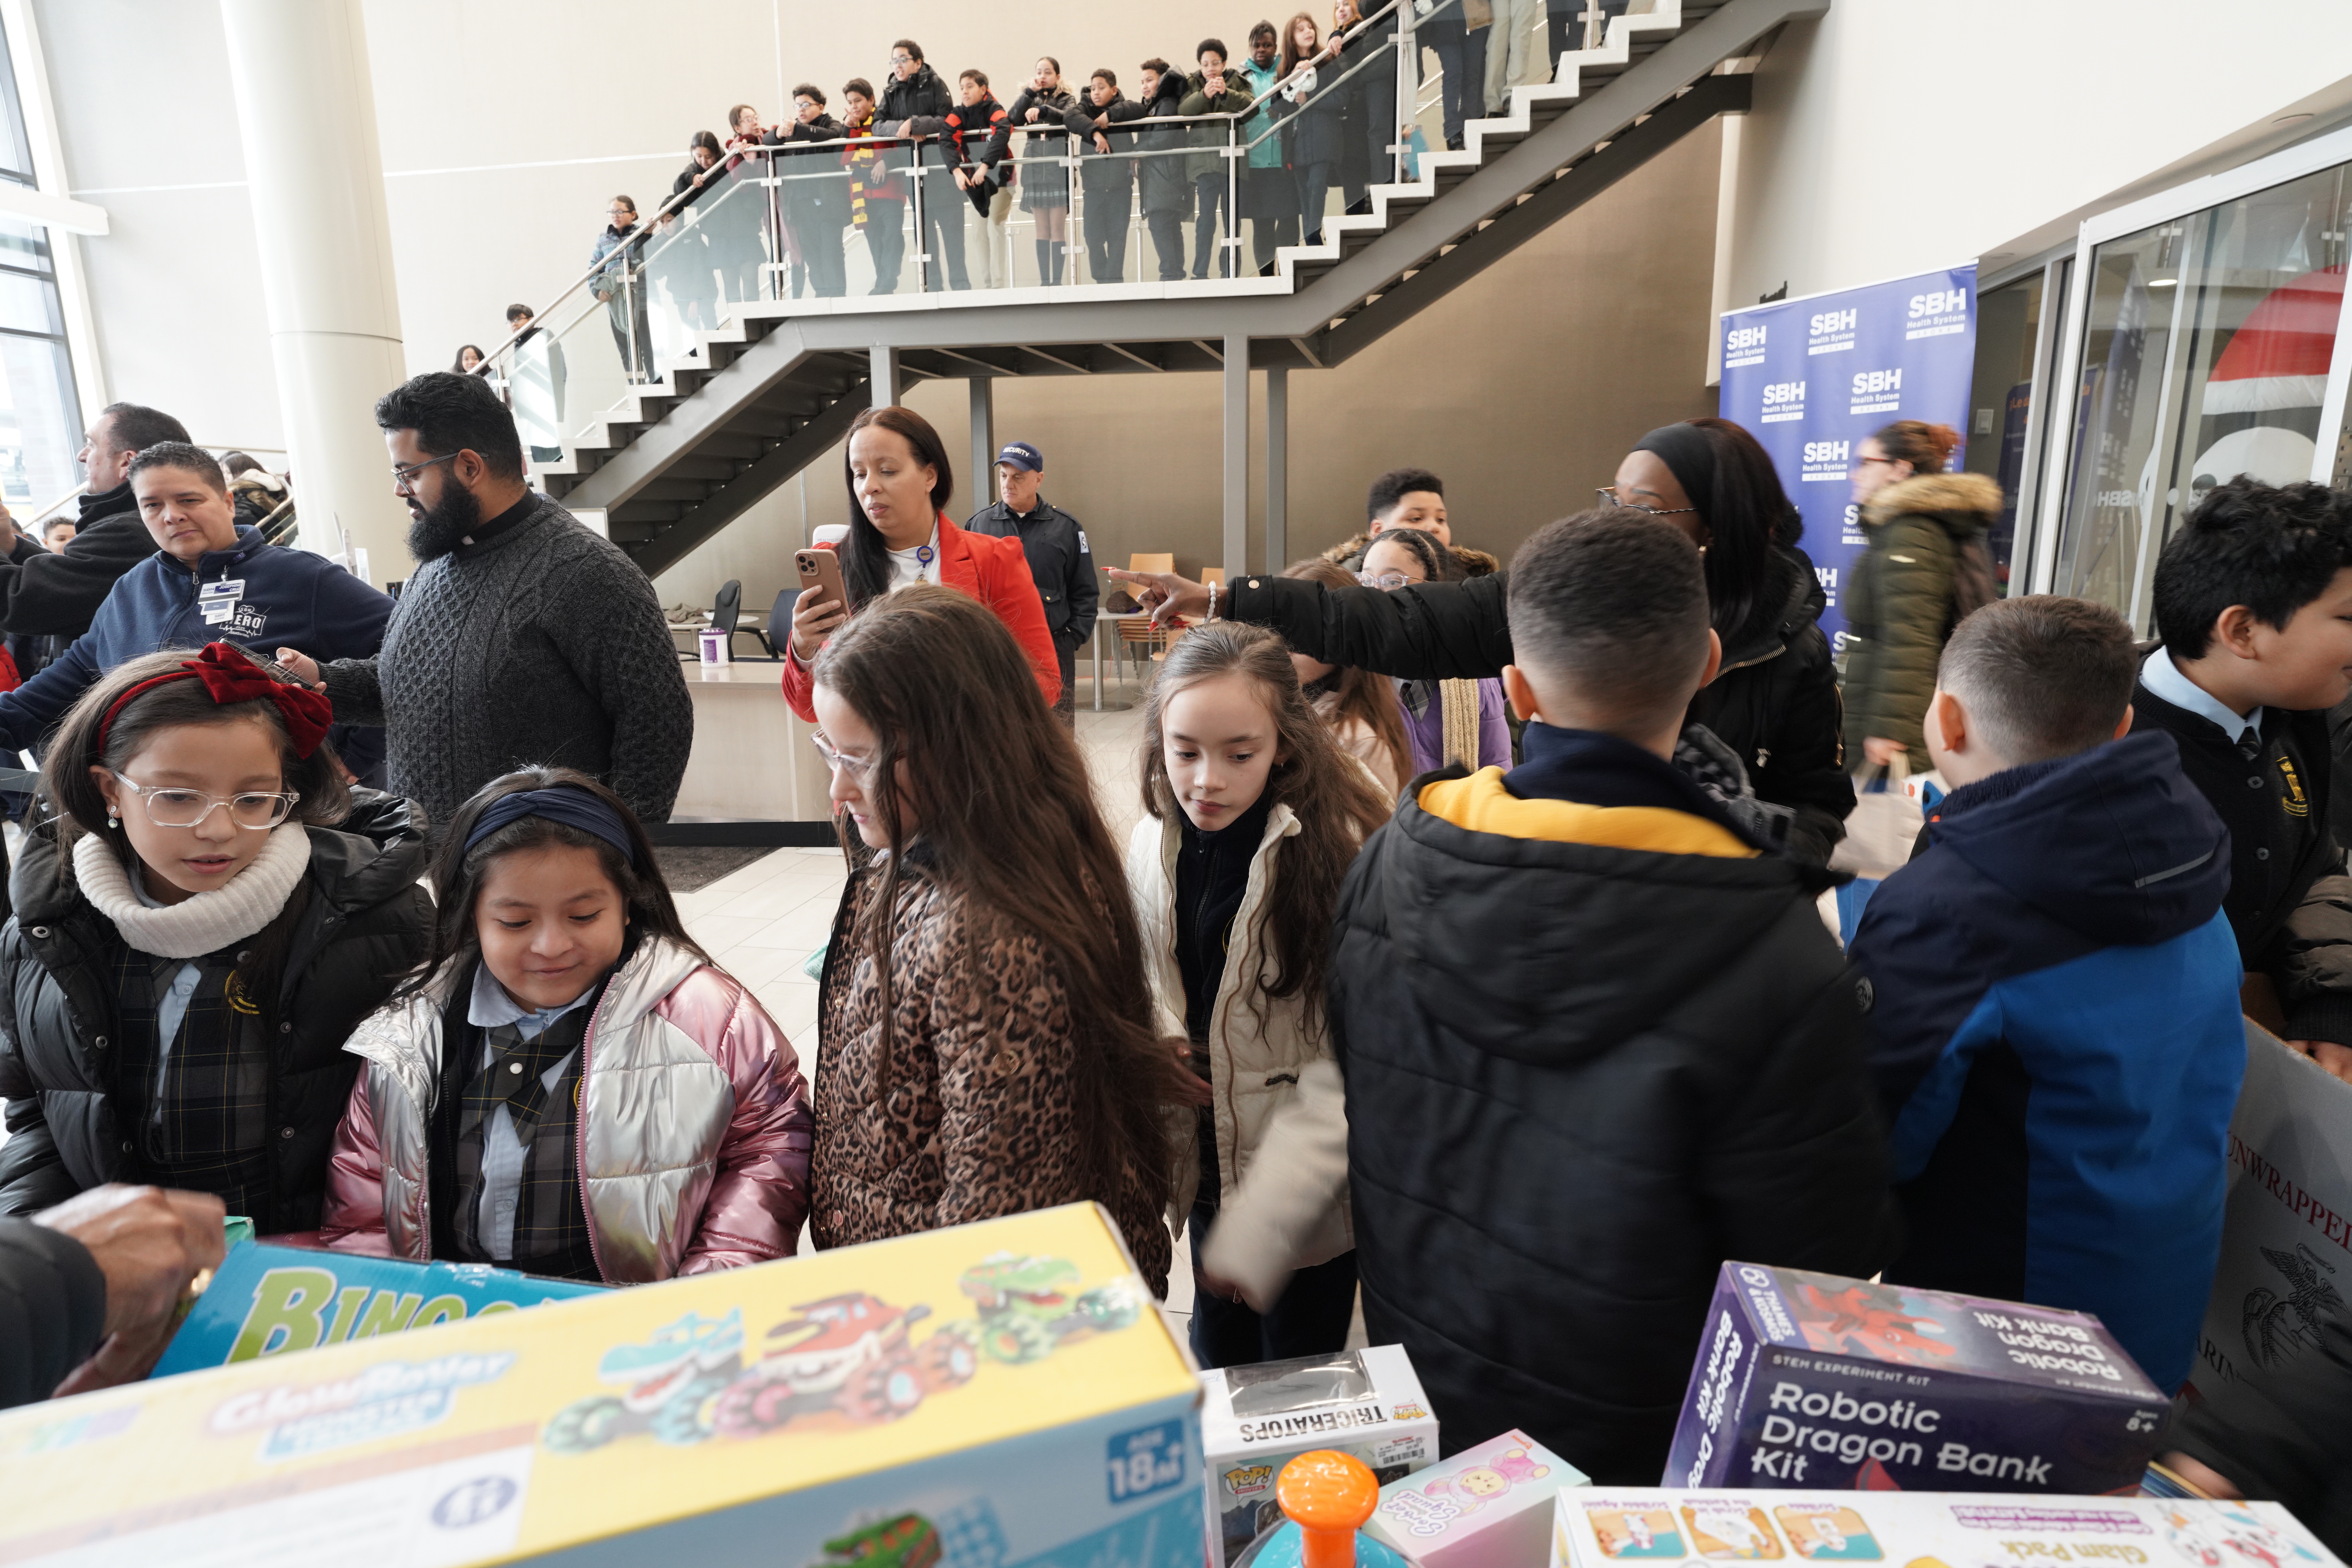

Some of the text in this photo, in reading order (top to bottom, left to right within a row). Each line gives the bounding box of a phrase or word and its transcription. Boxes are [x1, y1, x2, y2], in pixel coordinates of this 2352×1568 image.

[1908, 288, 1966, 318] SBH
[1810, 308, 1857, 335] SBH
[1907, 314, 1965, 329] Health System
[1727, 325, 1766, 350] SBH
[1809, 332, 1854, 345] Health System
[1726, 348, 1765, 359] Health System
[1763, 381, 1805, 405] SBH
[1852, 368, 1902, 394] SBH
[1762, 404, 1804, 413] Health System
[1851, 393, 1899, 404] Health System
[1003, 447, 1030, 457] SECURITY
[1804, 441, 1849, 463] SBH
[1823, 463, 1847, 472] System
[1750, 1298, 1784, 1341] KOSMOS
[1763, 1290, 1795, 1337] THAMES
[1973, 1312, 2090, 1342] Bank Kit
[1997, 1332, 2105, 1361] Dragon
[1696, 1310, 1733, 1419] Bank Kit
[1773, 1354, 1931, 1387] STEM EXPERIMENT KIT
[2008, 1349, 2122, 1381] Robotic
[1711, 1331, 1743, 1432] Robotic
[1394, 1406, 1427, 1419] POP!
[1770, 1383, 1941, 1432] Robotic
[1239, 1405, 1387, 1442] TRICERATOPS
[2126, 1417, 2154, 1433] 8+
[1761, 1416, 2053, 1484] Dragon Bank
[1224, 1465, 1272, 1490] POP!
[1750, 1448, 1808, 1482] Kit
[1386, 1503, 1442, 1534] Sorbet
[1396, 1493, 1456, 1519] Squad
[2000, 1540, 2148, 1564] Glam Pack
